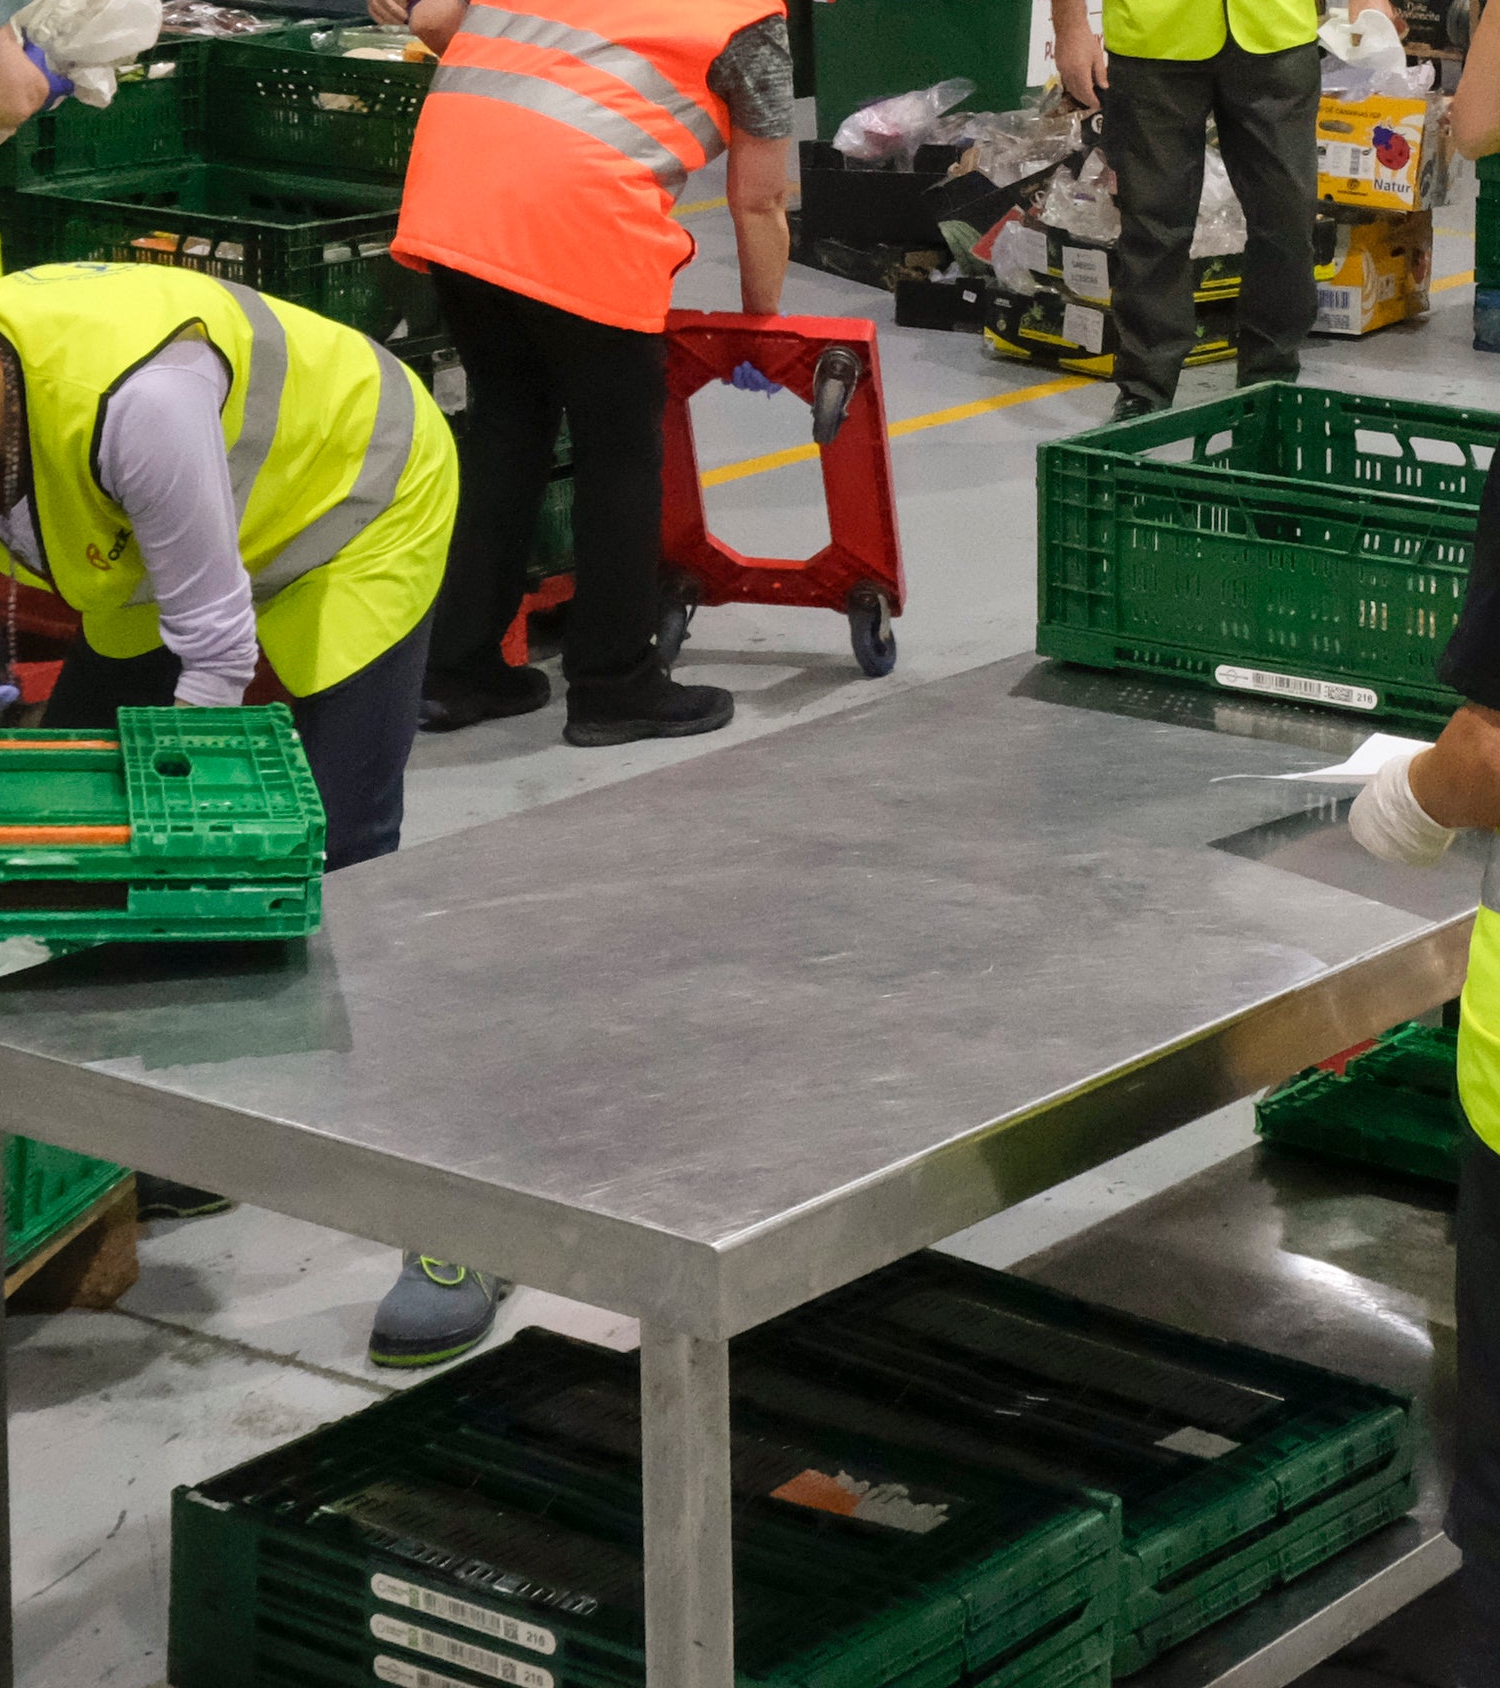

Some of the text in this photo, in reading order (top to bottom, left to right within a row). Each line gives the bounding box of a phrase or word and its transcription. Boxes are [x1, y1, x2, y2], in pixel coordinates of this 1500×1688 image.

[1373, 177, 1412, 194] Natur
[1356, 693, 1373, 705] 216
[527, 1631, 546, 1648] 216
[524, 1672, 545, 1688] 216
